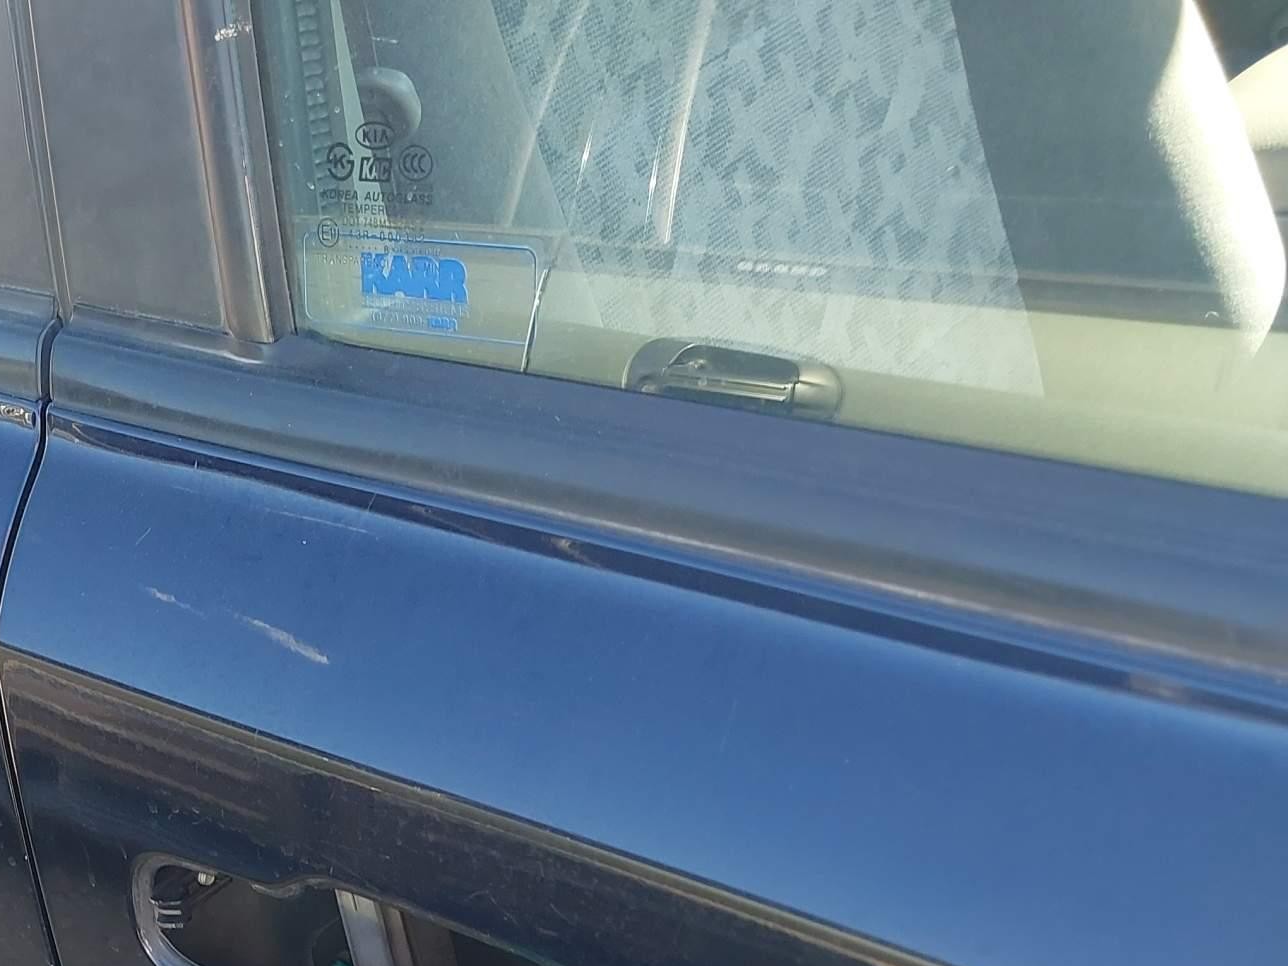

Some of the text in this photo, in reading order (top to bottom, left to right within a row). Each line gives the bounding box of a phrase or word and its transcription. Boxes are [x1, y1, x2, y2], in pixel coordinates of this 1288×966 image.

[361, 127, 390, 145] KIA
[321, 188, 359, 202] KOREA
[360, 252, 469, 305] KARR
